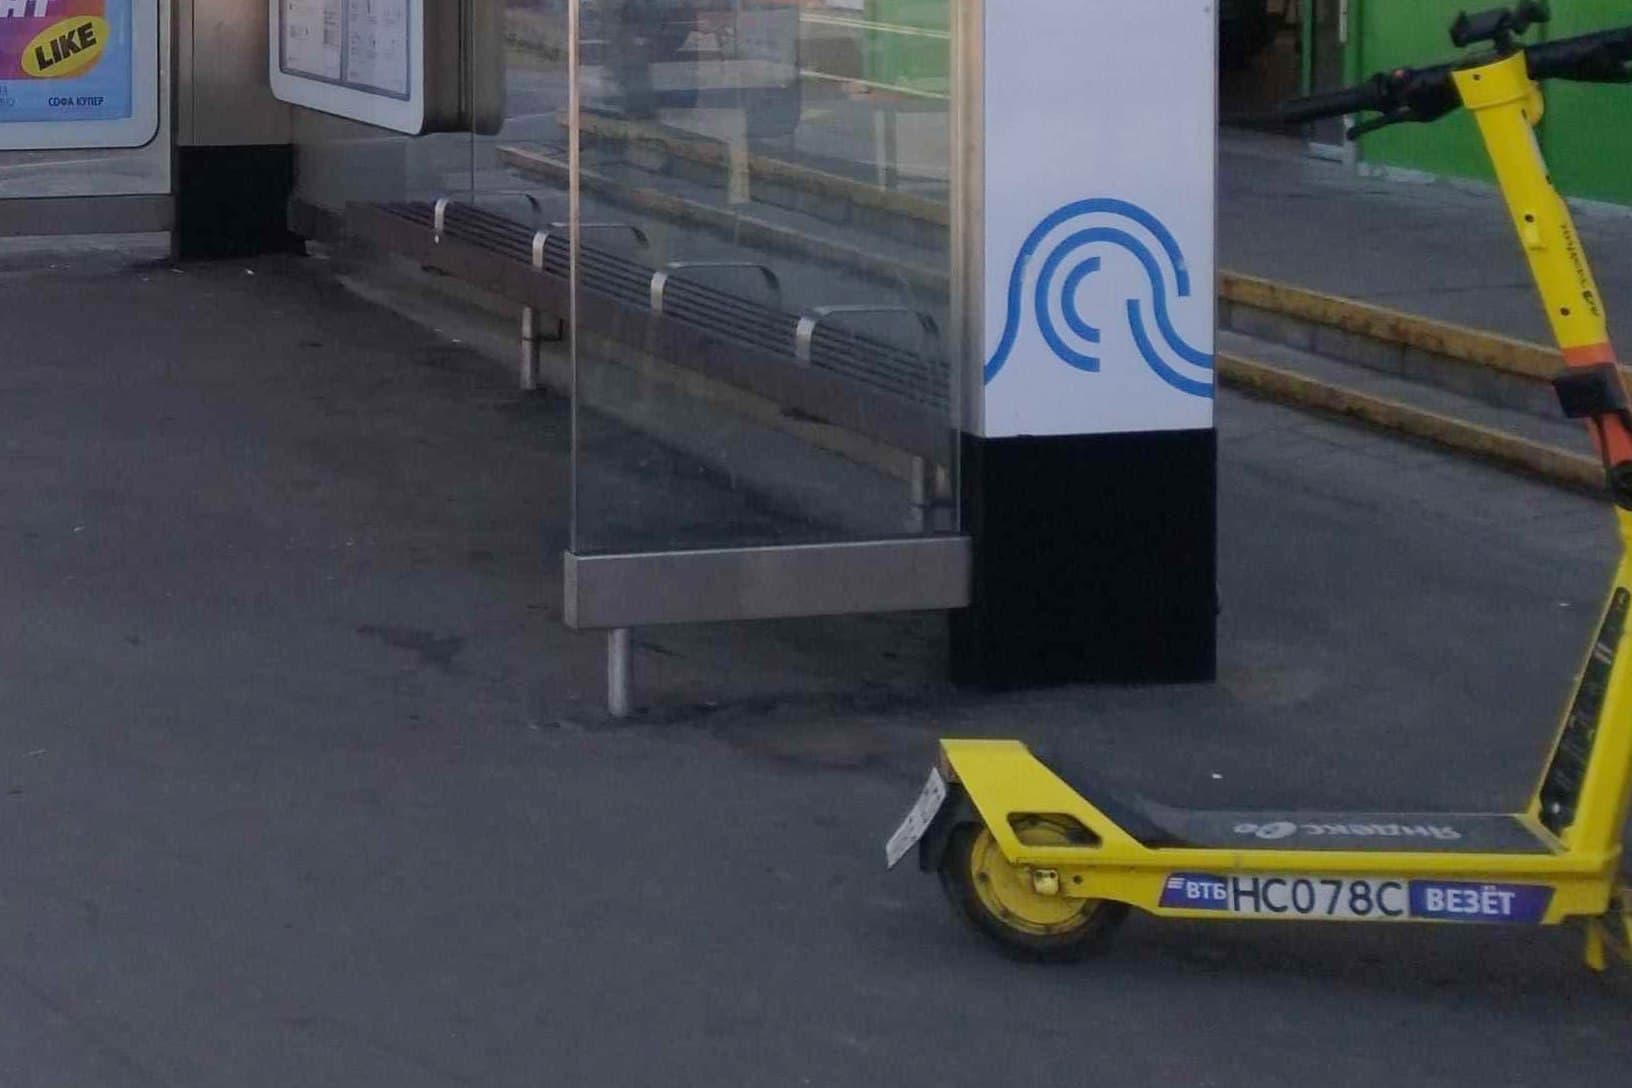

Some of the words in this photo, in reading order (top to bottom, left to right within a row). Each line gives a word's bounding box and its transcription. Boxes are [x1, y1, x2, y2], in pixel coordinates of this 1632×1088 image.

[35, 22, 97, 72] LIKE
[1186, 880, 1227, 900] ВТБ
[1425, 885, 1516, 916] ВЕЗЁТ
